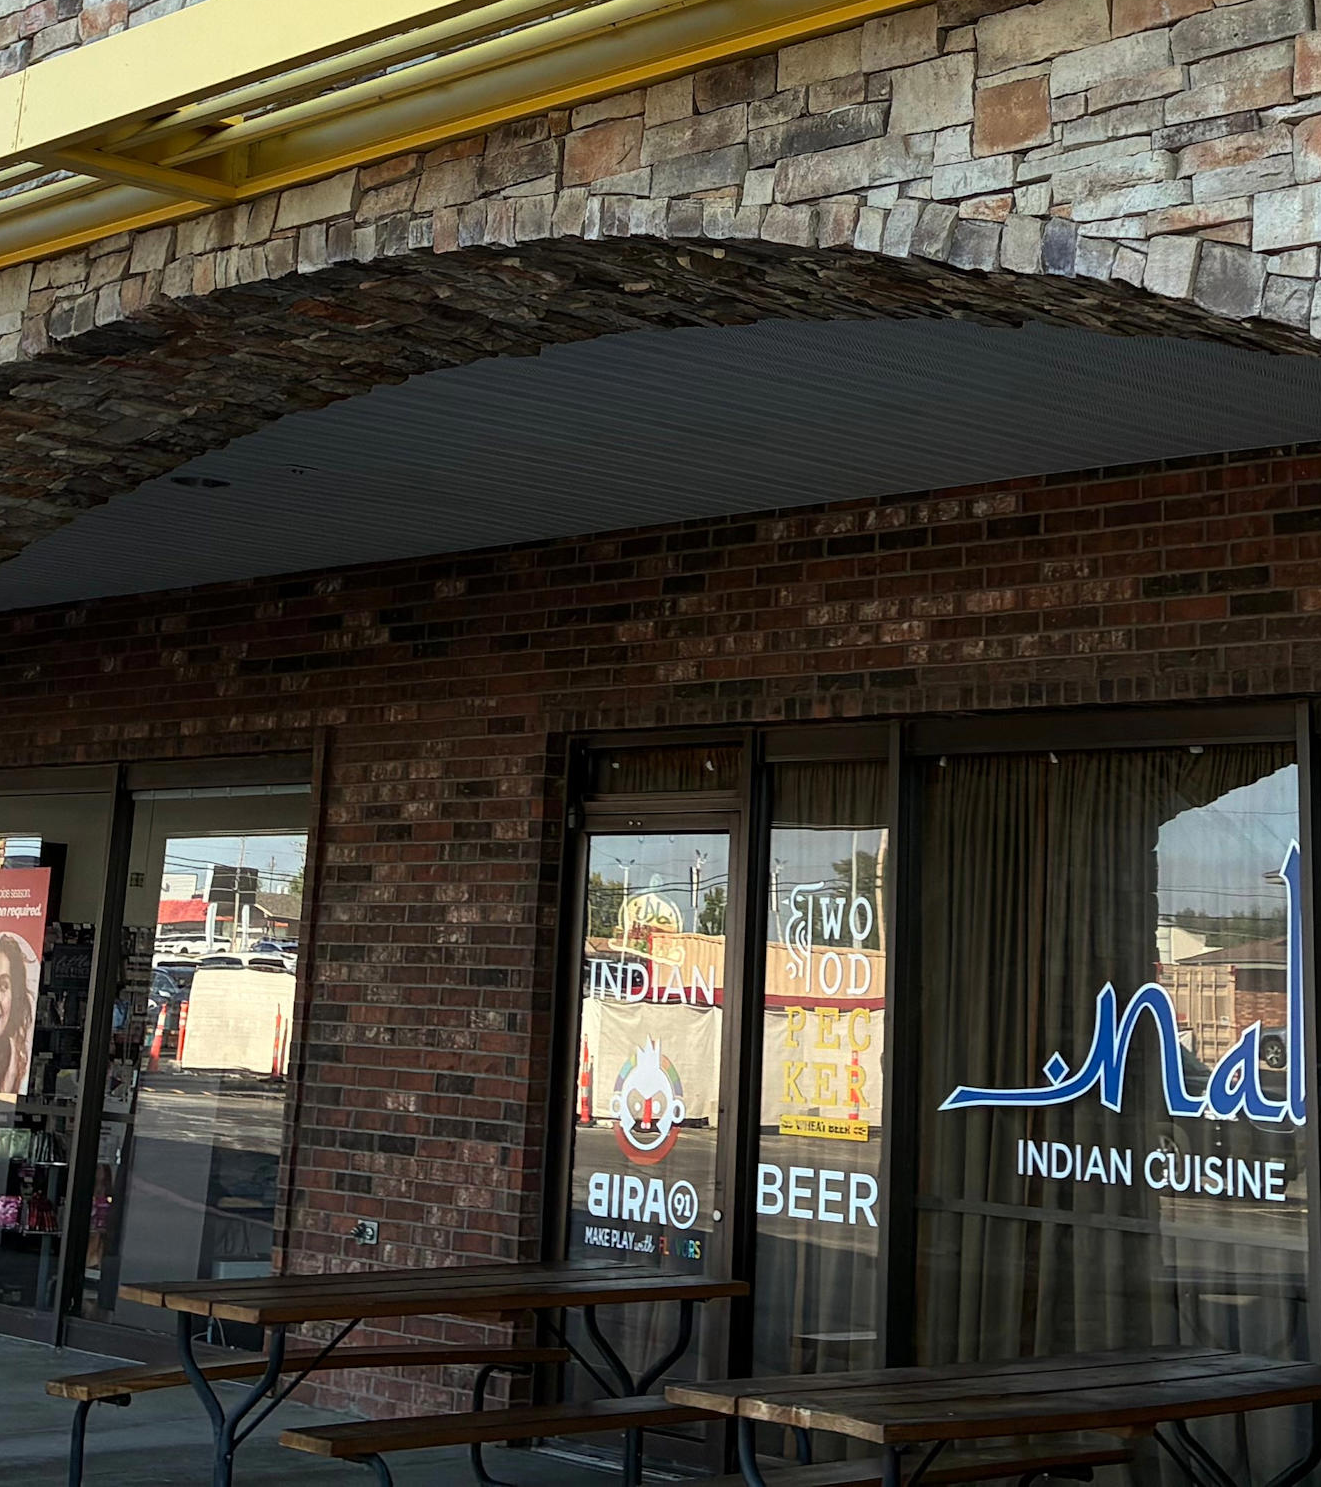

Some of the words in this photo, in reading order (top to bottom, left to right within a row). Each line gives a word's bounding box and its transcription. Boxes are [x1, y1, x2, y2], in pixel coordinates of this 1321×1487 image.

[6, 902, 43, 920] required.
[589, 962, 715, 1006] INDIAN
[783, 1005, 872, 1052] PEC
[781, 1060, 871, 1108] KER
[828, 1124, 851, 1135] BEER
[1016, 1138, 1134, 1187] INDIAN
[1143, 1147, 1287, 1203] CUISINE
[587, 1172, 668, 1225] BIRA
[756, 1163, 879, 1227] BEER
[584, 1226, 611, 1247] MAKE
[610, 1229, 636, 1251] PLAY
